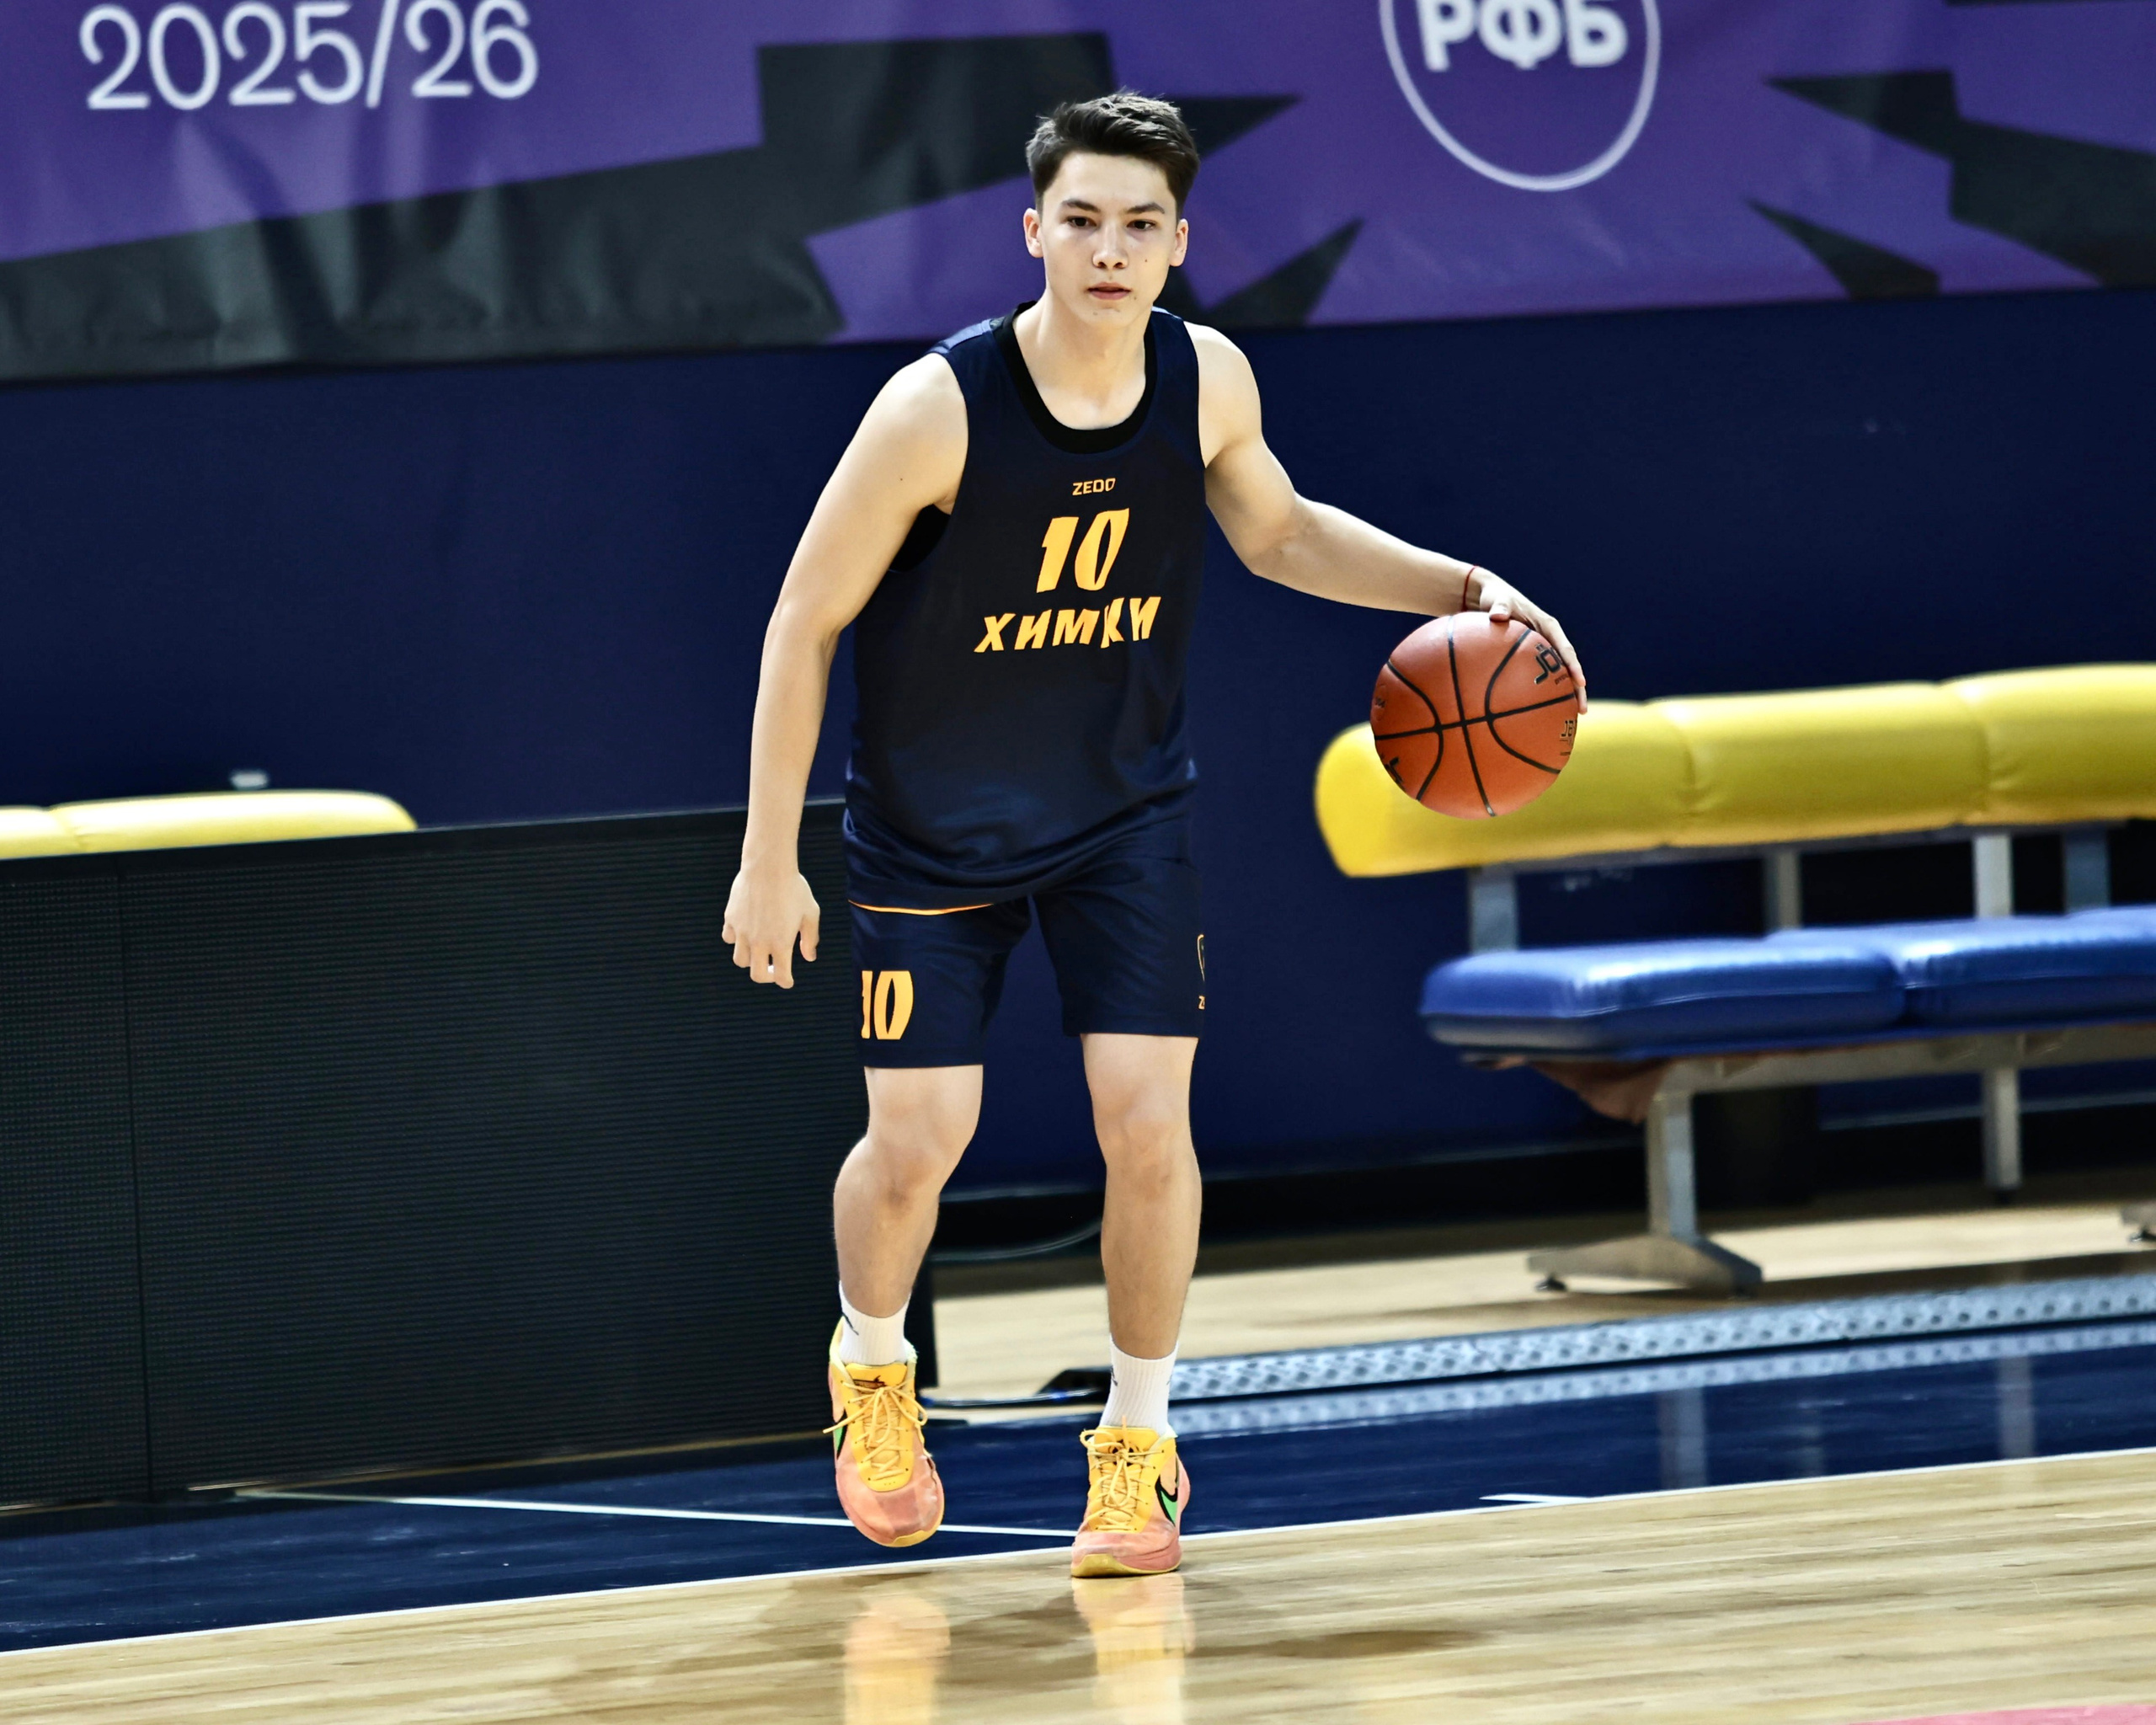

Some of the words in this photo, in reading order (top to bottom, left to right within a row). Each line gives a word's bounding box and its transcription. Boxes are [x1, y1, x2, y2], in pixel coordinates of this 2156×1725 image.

[80, 0, 538, 110] 2025/26
[1417, 0, 1628, 72] РФБ
[1036, 508, 1130, 593] 10
[974, 595, 1162, 653] ХИМКИ
[861, 969, 914, 1040] 10
